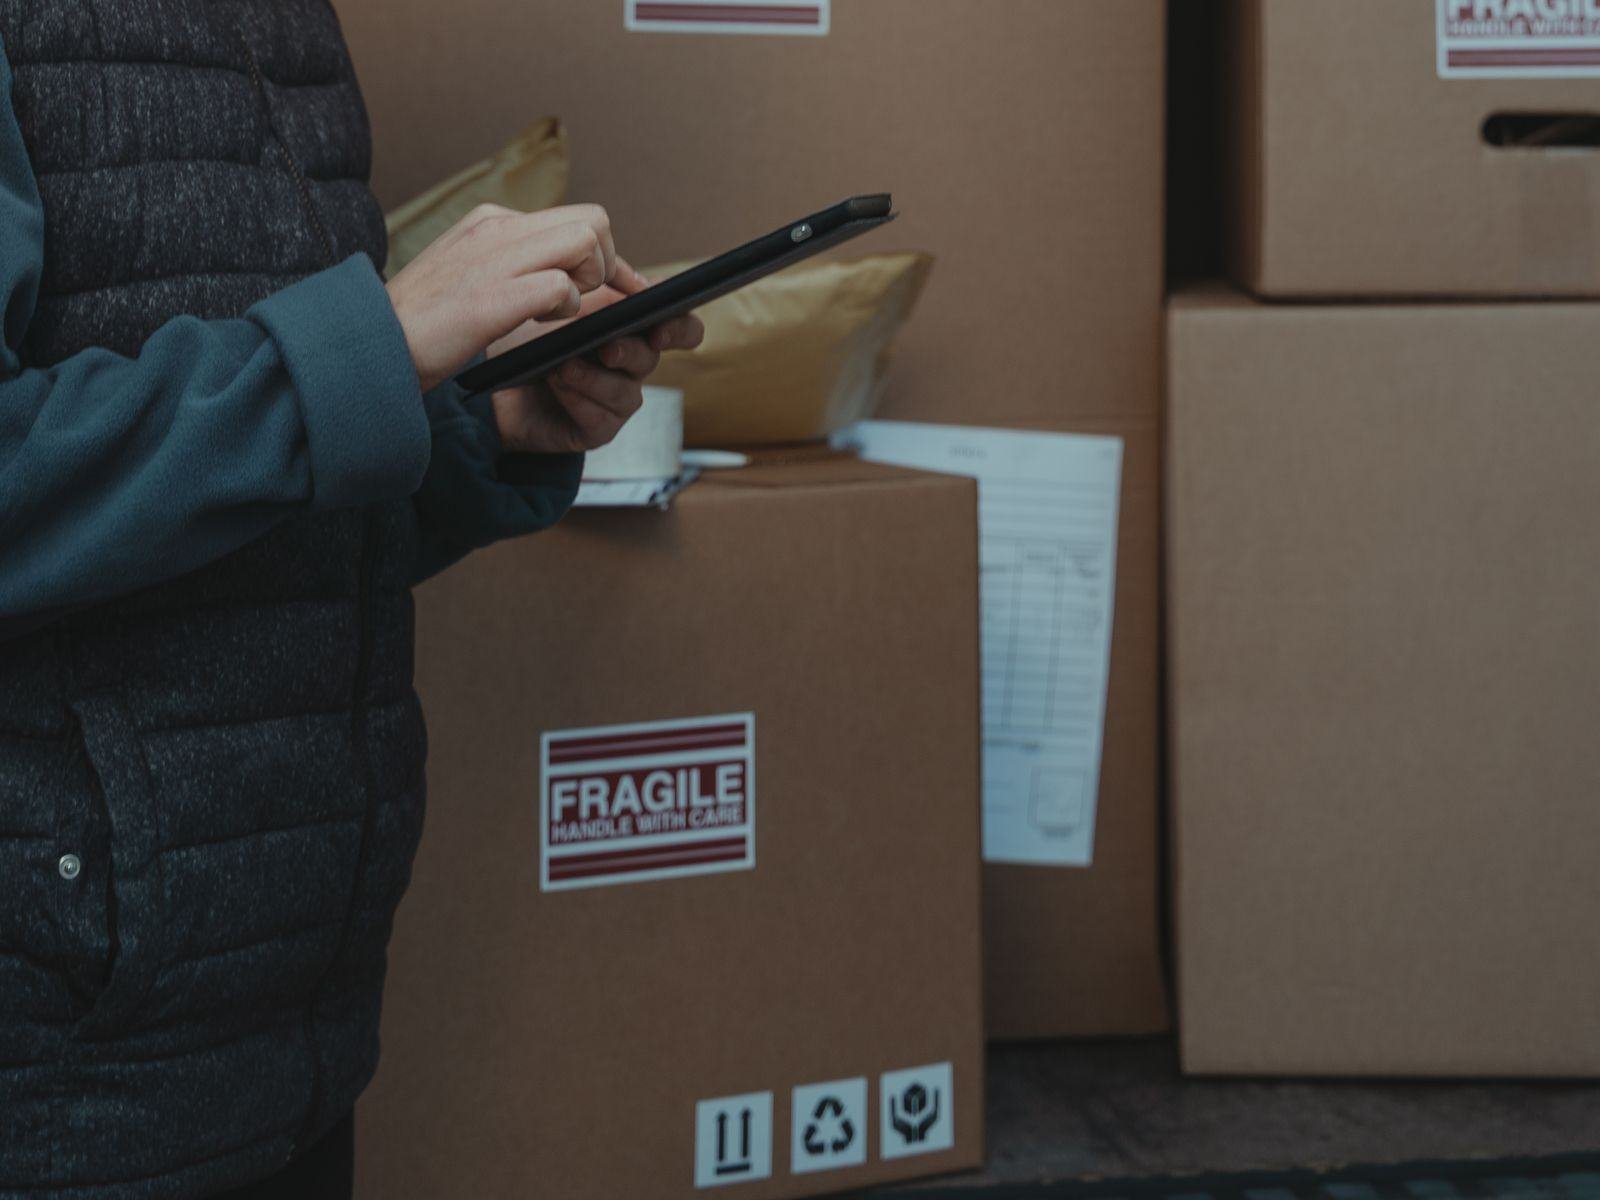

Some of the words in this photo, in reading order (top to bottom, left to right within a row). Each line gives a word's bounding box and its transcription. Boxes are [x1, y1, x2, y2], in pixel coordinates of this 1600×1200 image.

[551, 763, 744, 822] FRAGILE
[551, 817, 633, 843] HANDLE
[637, 811, 687, 833] WITH
[689, 805, 743, 827] CARE
